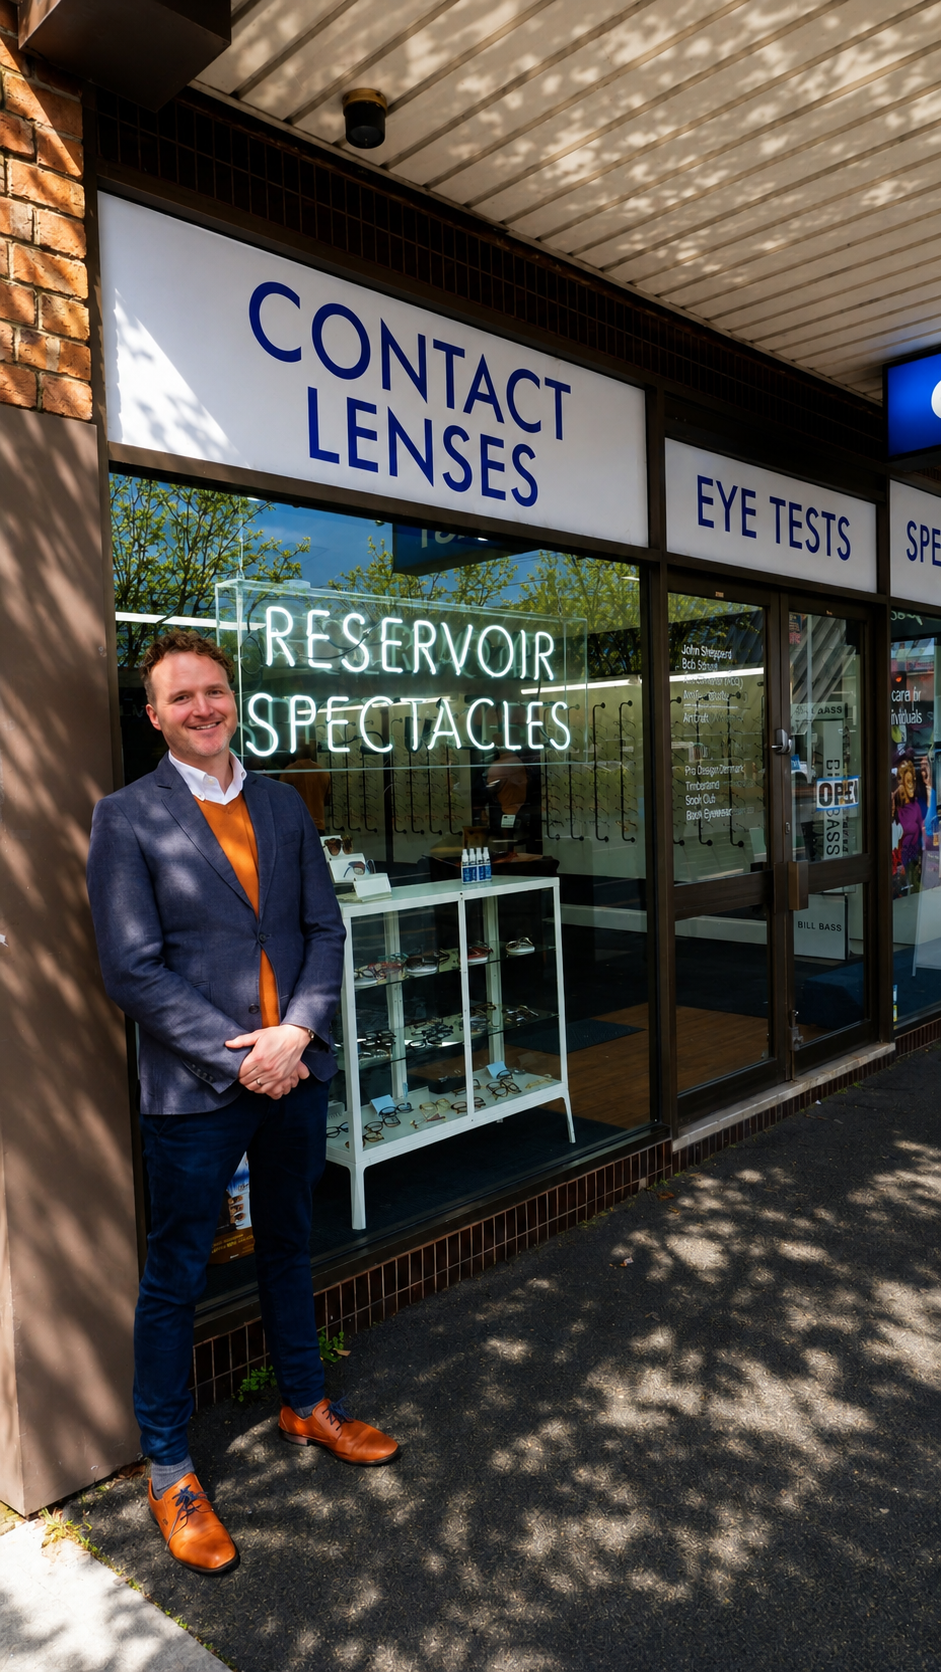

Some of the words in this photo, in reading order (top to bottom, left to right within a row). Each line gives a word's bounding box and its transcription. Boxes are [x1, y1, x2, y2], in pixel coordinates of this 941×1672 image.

[248, 281, 571, 440] CONTACT
[307, 386, 538, 507] LENSES
[697, 474, 757, 539] EYE
[769, 495, 851, 561] TESTS
[906, 520, 941, 567] SPE
[264, 606, 555, 681] RESERVOIR
[681, 644, 700, 655] John
[245, 693, 572, 757] SPECTACLES
[797, 921, 815, 930] BILL
[818, 922, 842, 932] BASS
